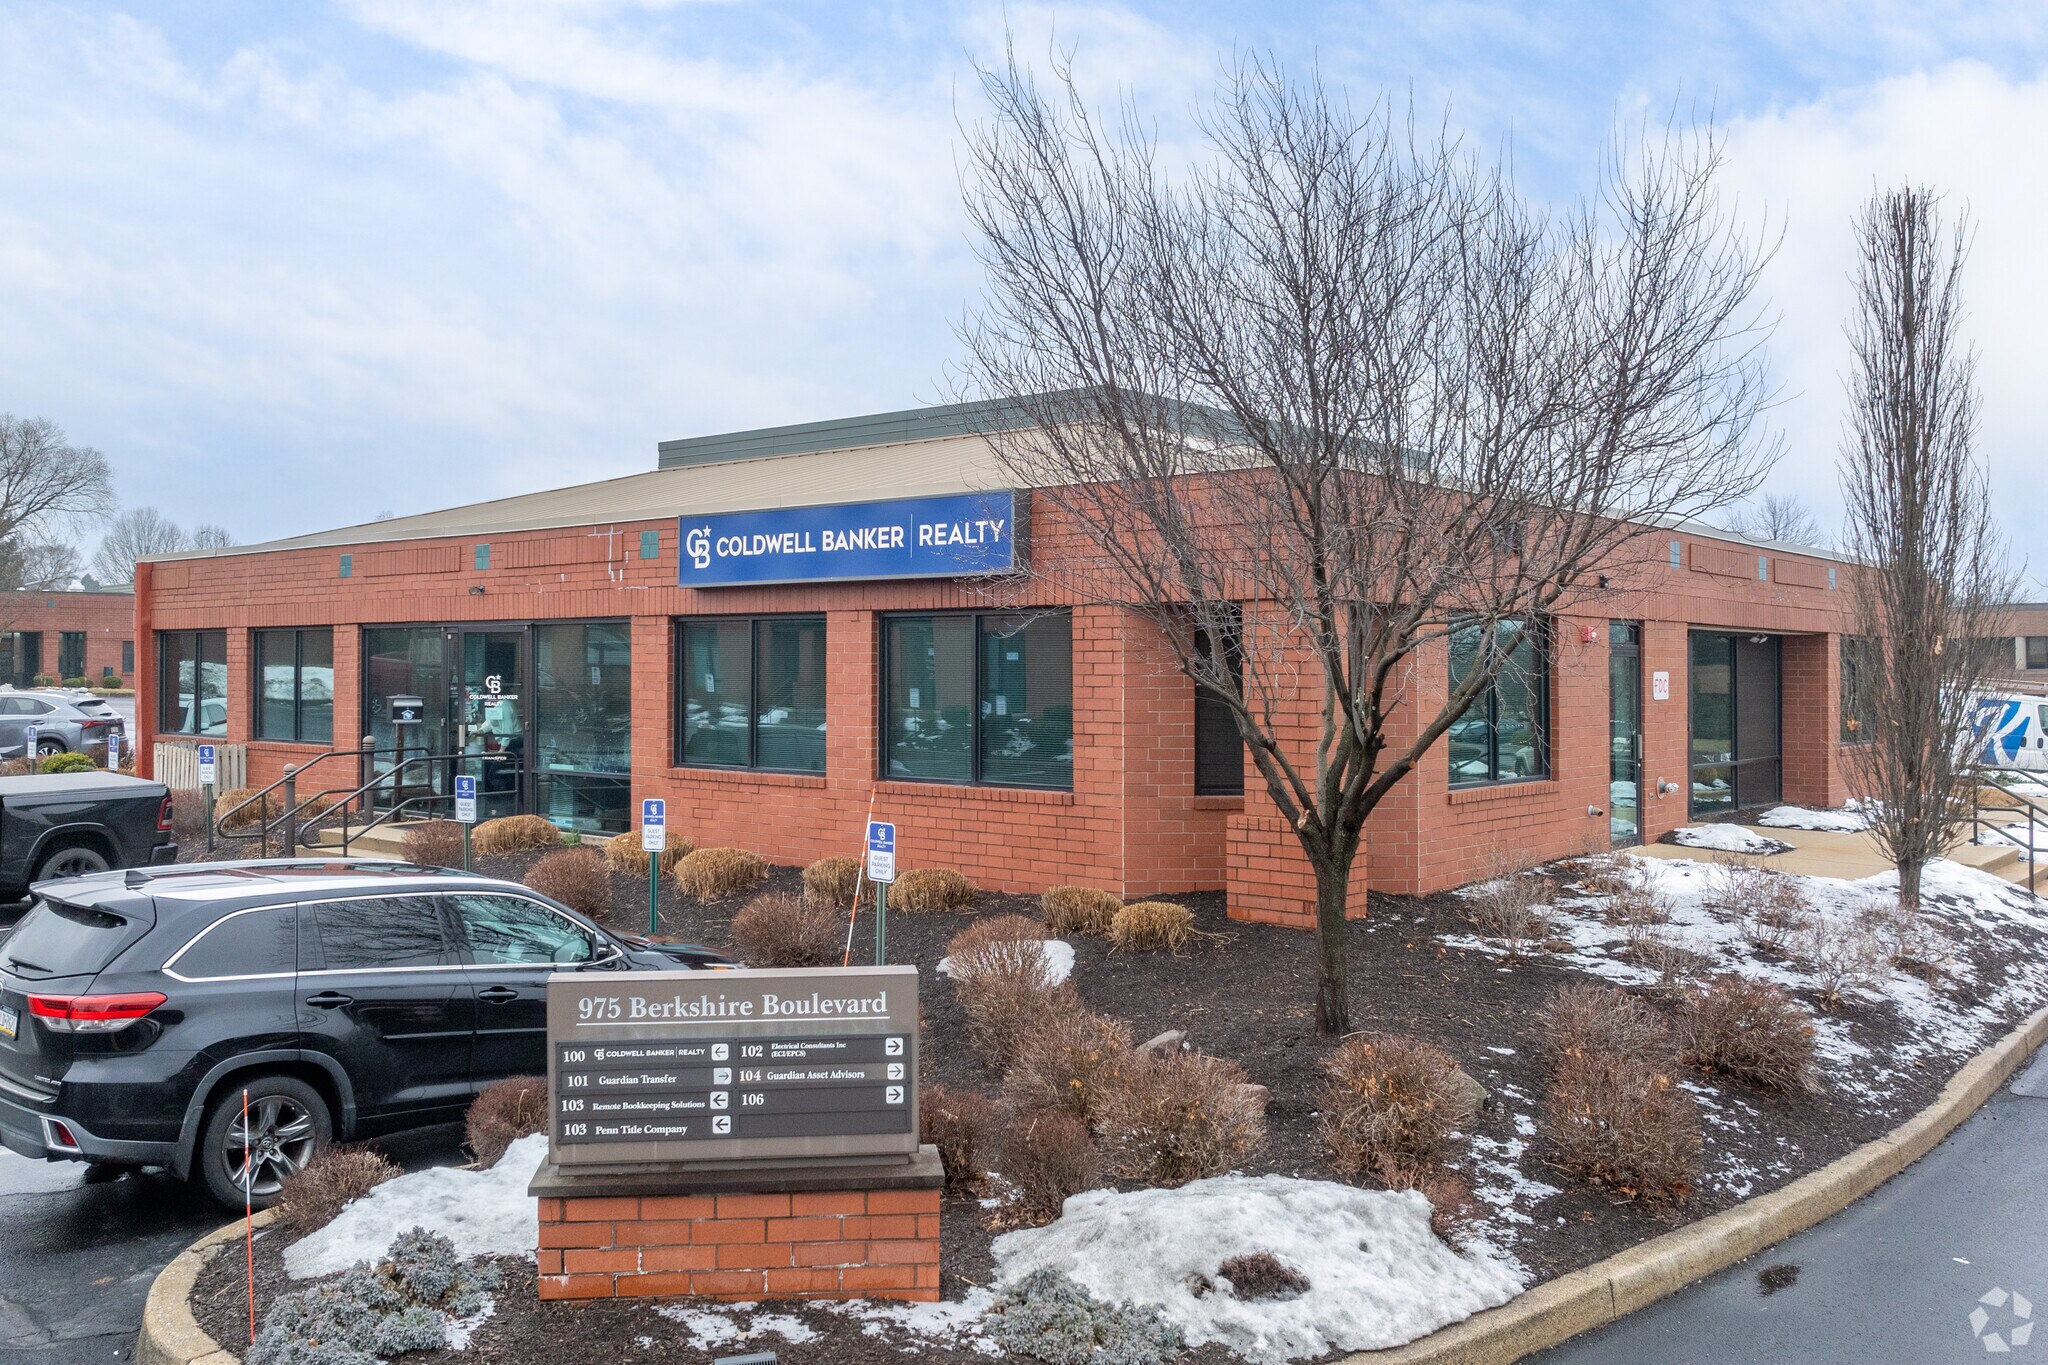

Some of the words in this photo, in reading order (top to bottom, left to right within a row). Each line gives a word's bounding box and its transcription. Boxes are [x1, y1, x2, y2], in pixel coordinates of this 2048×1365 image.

[716, 531, 816, 557] COLDWELL
[822, 526, 904, 551] BANKER
[919, 519, 1005, 546] REALTY
[871, 861, 891, 869] PARKING
[578, 996, 621, 1019] 975
[629, 994, 753, 1018] Berkshire
[762, 991, 888, 1015] Boulevard
[564, 1051, 586, 1062] 100
[606, 1050, 645, 1058] COLDWELL
[678, 1048, 705, 1056] REALTY
[741, 1045, 763, 1057] 102
[771, 1042, 800, 1050] Electrical
[568, 1075, 588, 1087] 101
[599, 1075, 639, 1085] Guardian
[640, 1074, 677, 1084] Transfer
[739, 1070, 762, 1081] 104
[767, 1071, 805, 1080] Guardian
[807, 1070, 829, 1080] Asset
[830, 1069, 865, 1079] Advisors
[561, 1099, 584, 1111] 103
[592, 1102, 621, 1110] Remote
[622, 1100, 670, 1111] Bookkeeping
[671, 1100, 706, 1109] Solutions
[741, 1093, 764, 1106] 106
[564, 1123, 587, 1135] 103
[595, 1125, 619, 1135] Penn
[620, 1124, 642, 1134] Title
[643, 1124, 688, 1136] Company
